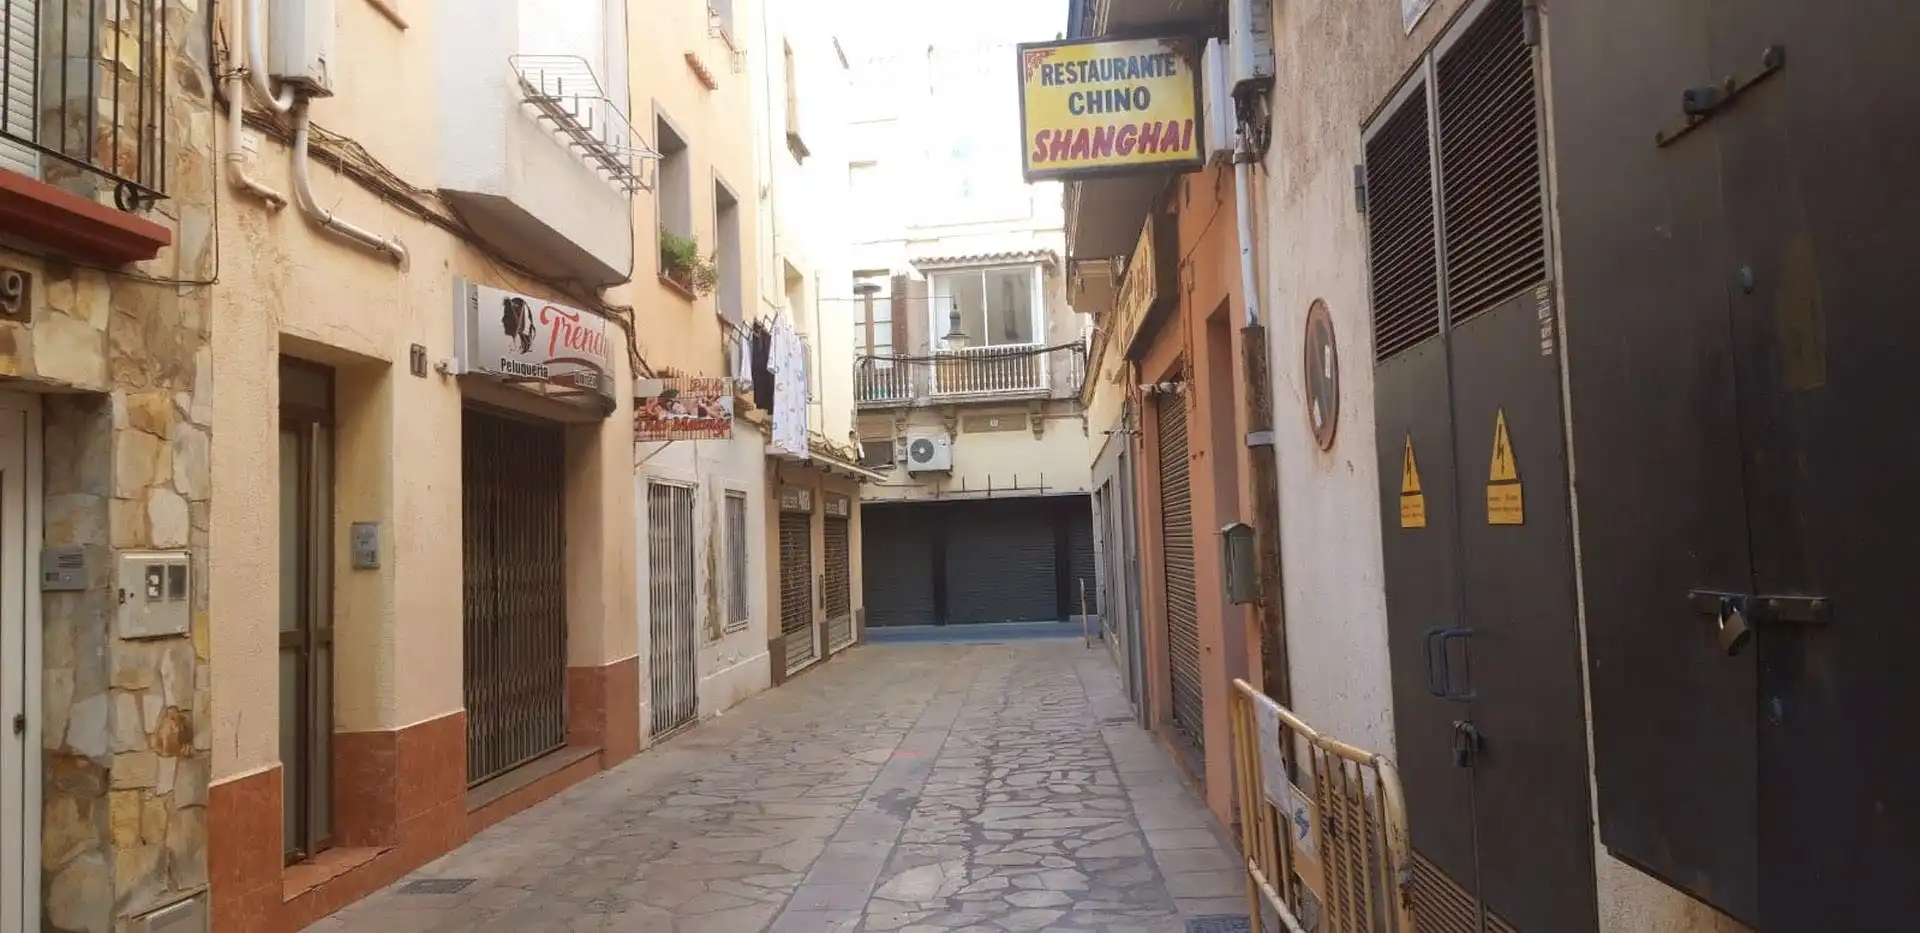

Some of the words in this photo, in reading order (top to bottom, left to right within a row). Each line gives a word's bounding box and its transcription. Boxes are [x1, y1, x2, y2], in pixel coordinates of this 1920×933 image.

[1041, 53, 1177, 87] RESTAURANTE
[1068, 85, 1151, 117] CHINO
[1032, 118, 1194, 164] SHANGHAI
